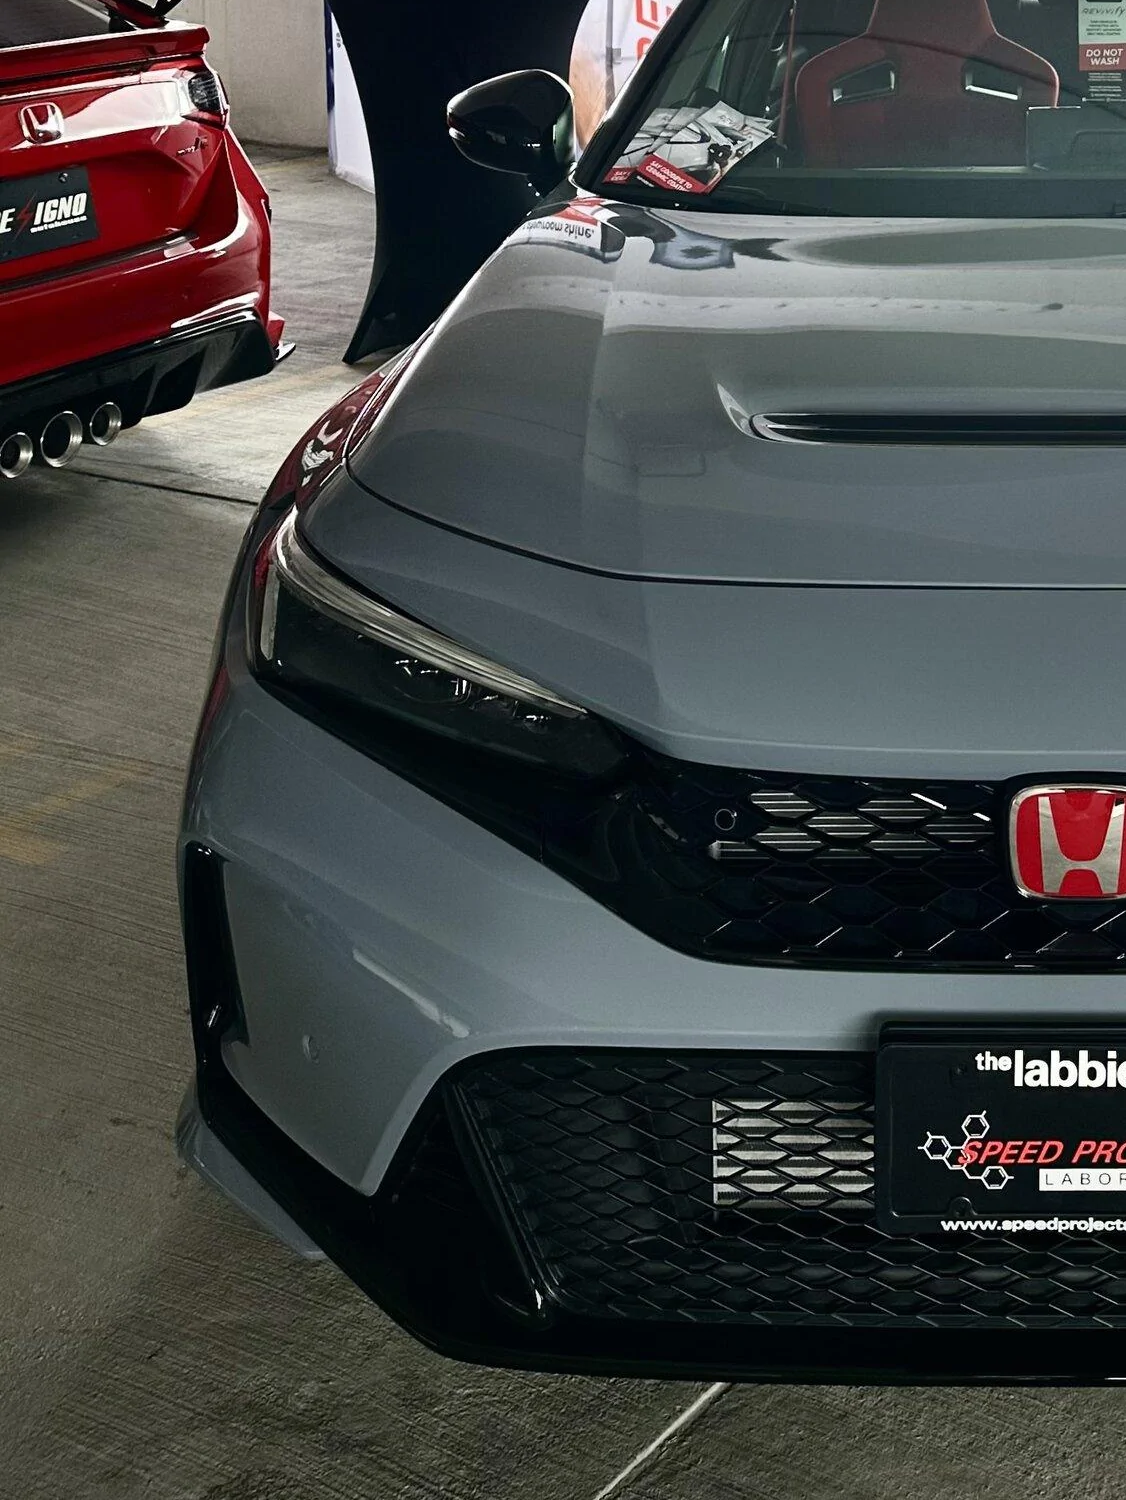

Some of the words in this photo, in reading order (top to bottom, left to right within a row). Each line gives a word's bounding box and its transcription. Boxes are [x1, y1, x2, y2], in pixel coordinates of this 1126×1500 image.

[1086, 49, 1101, 57] DO
[1103, 48, 1124, 56] NOT
[1090, 57, 1120, 65] WASH
[650, 160, 662, 169] SAY
[683, 180, 693, 189] TO
[0, 208, 16, 234] E
[975, 1051, 1012, 1072] the
[958, 1139, 1063, 1165] SPEED
